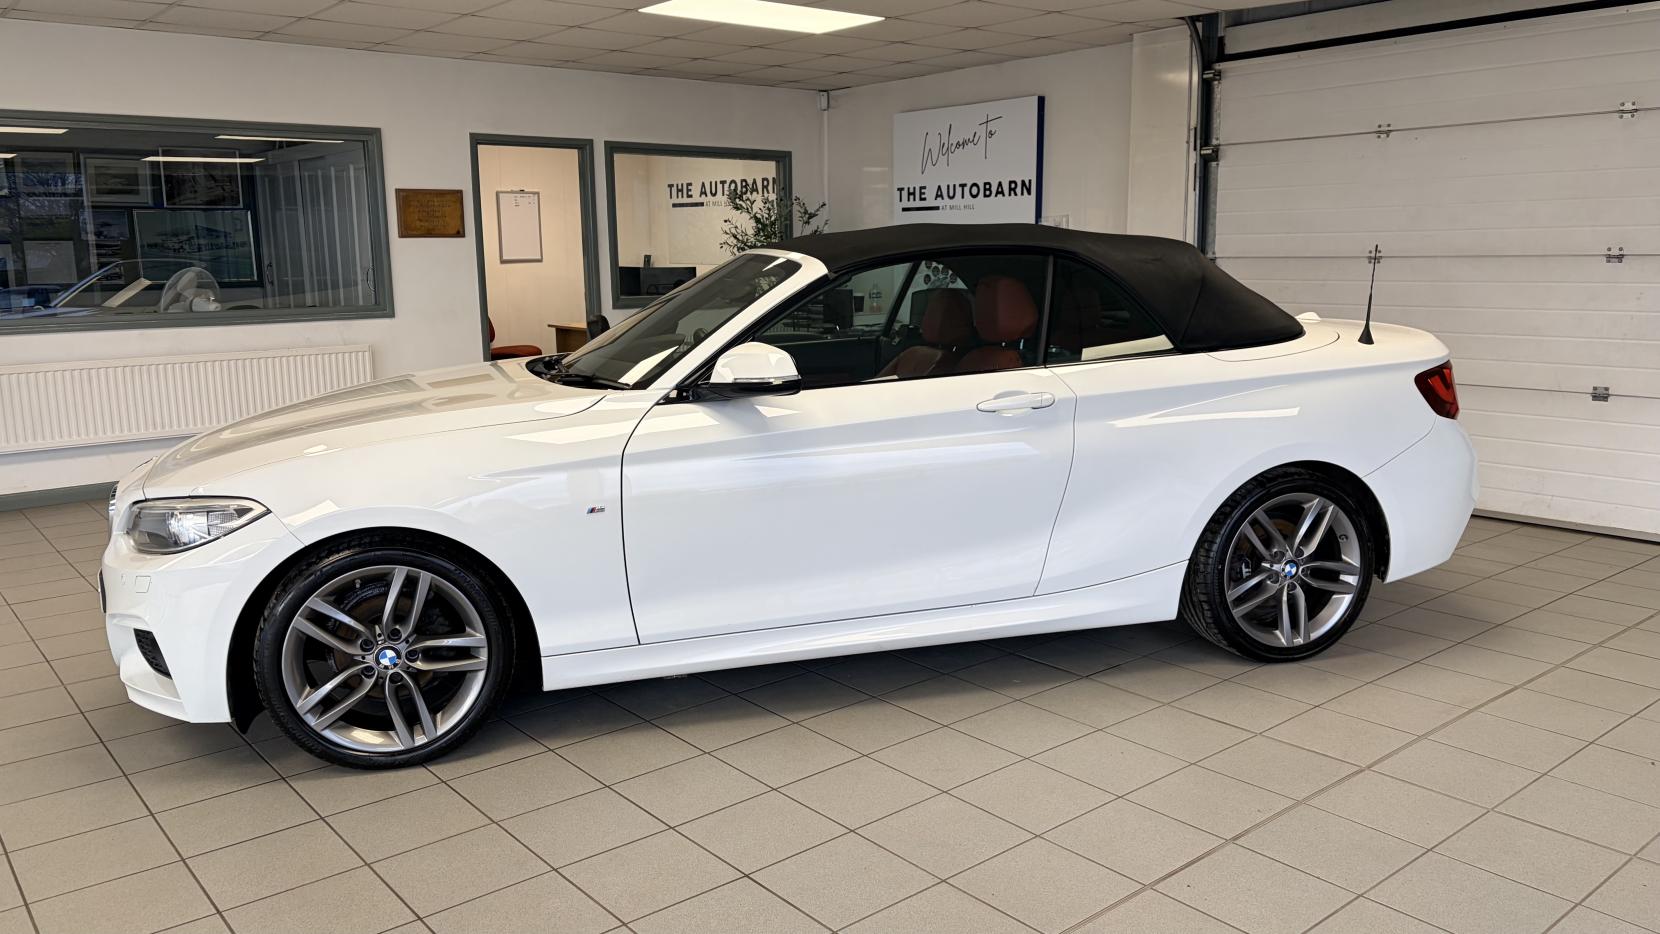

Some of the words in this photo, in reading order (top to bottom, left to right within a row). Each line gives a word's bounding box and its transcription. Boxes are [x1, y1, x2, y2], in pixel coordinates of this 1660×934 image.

[921, 123, 981, 175] Welcome
[667, 182, 693, 199] THE
[896, 185, 927, 203] THE
[934, 178, 1032, 201] AUTOBARN
